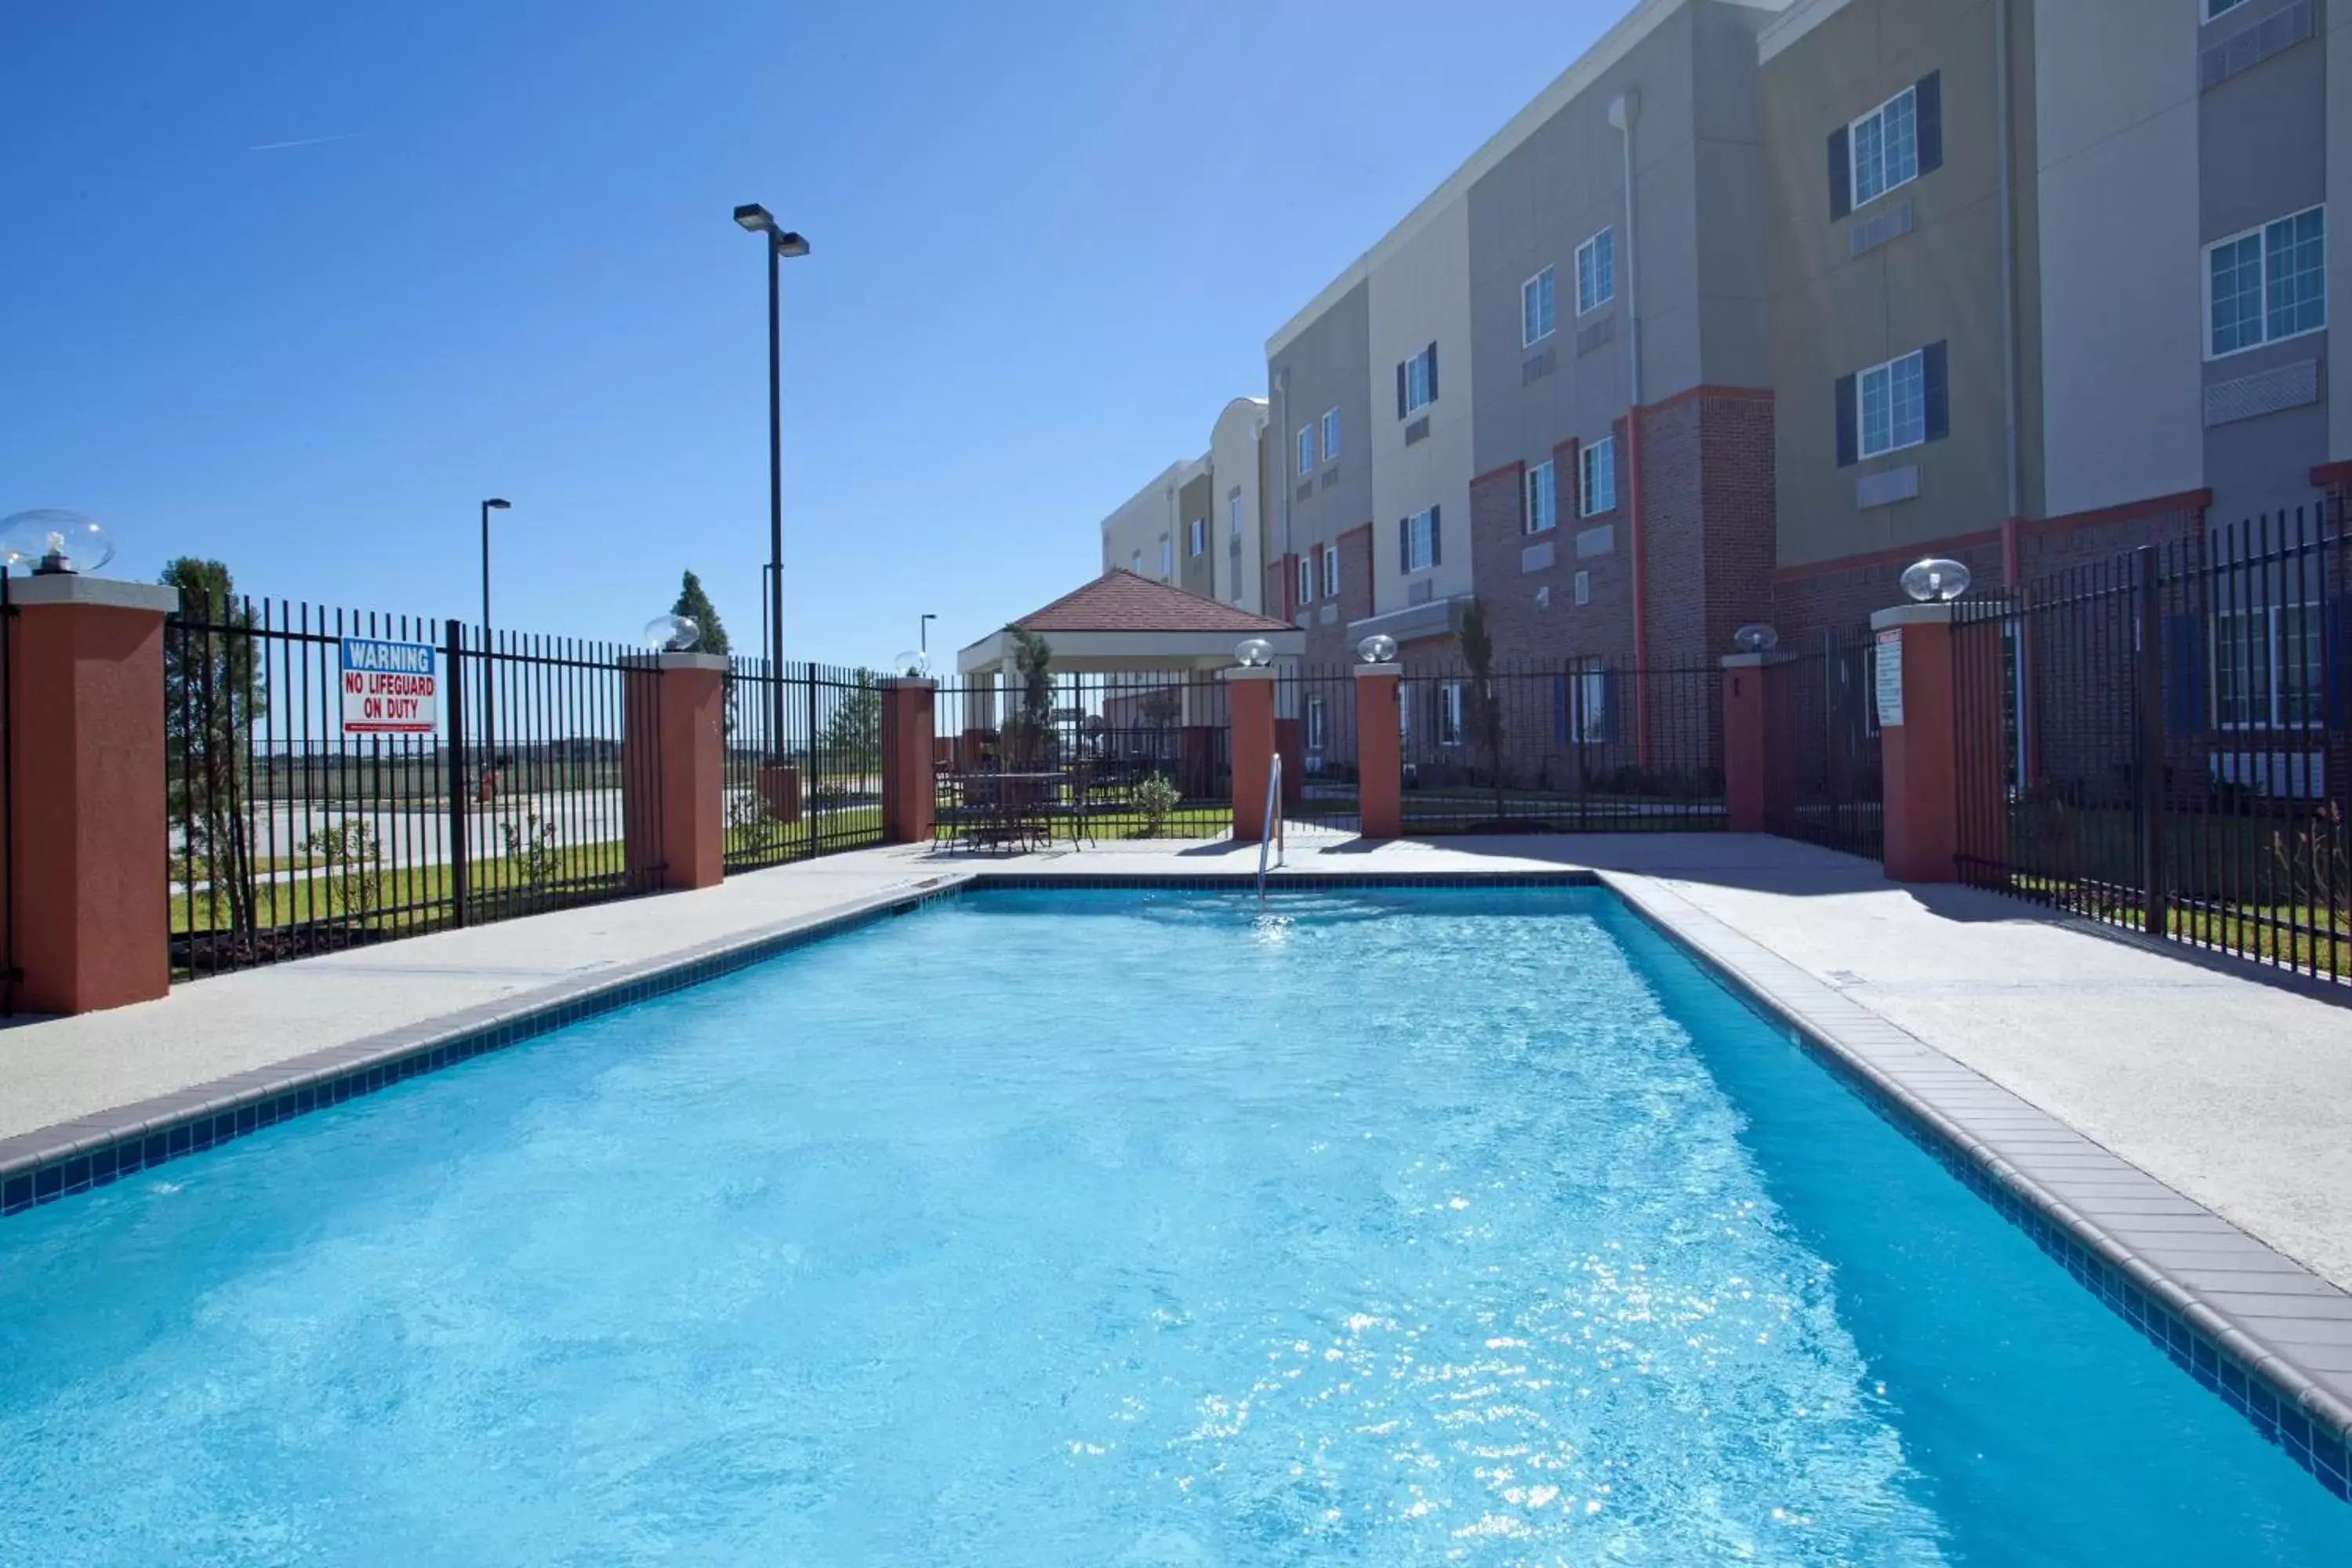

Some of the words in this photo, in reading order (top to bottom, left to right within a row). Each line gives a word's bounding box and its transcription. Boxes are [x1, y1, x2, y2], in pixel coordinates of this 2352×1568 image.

[350, 642, 429, 672] WARNING
[346, 672, 363, 694] NO
[369, 673, 434, 696] LIFEGUARD
[364, 697, 382, 719] ON
[387, 698, 419, 719] DUTY
